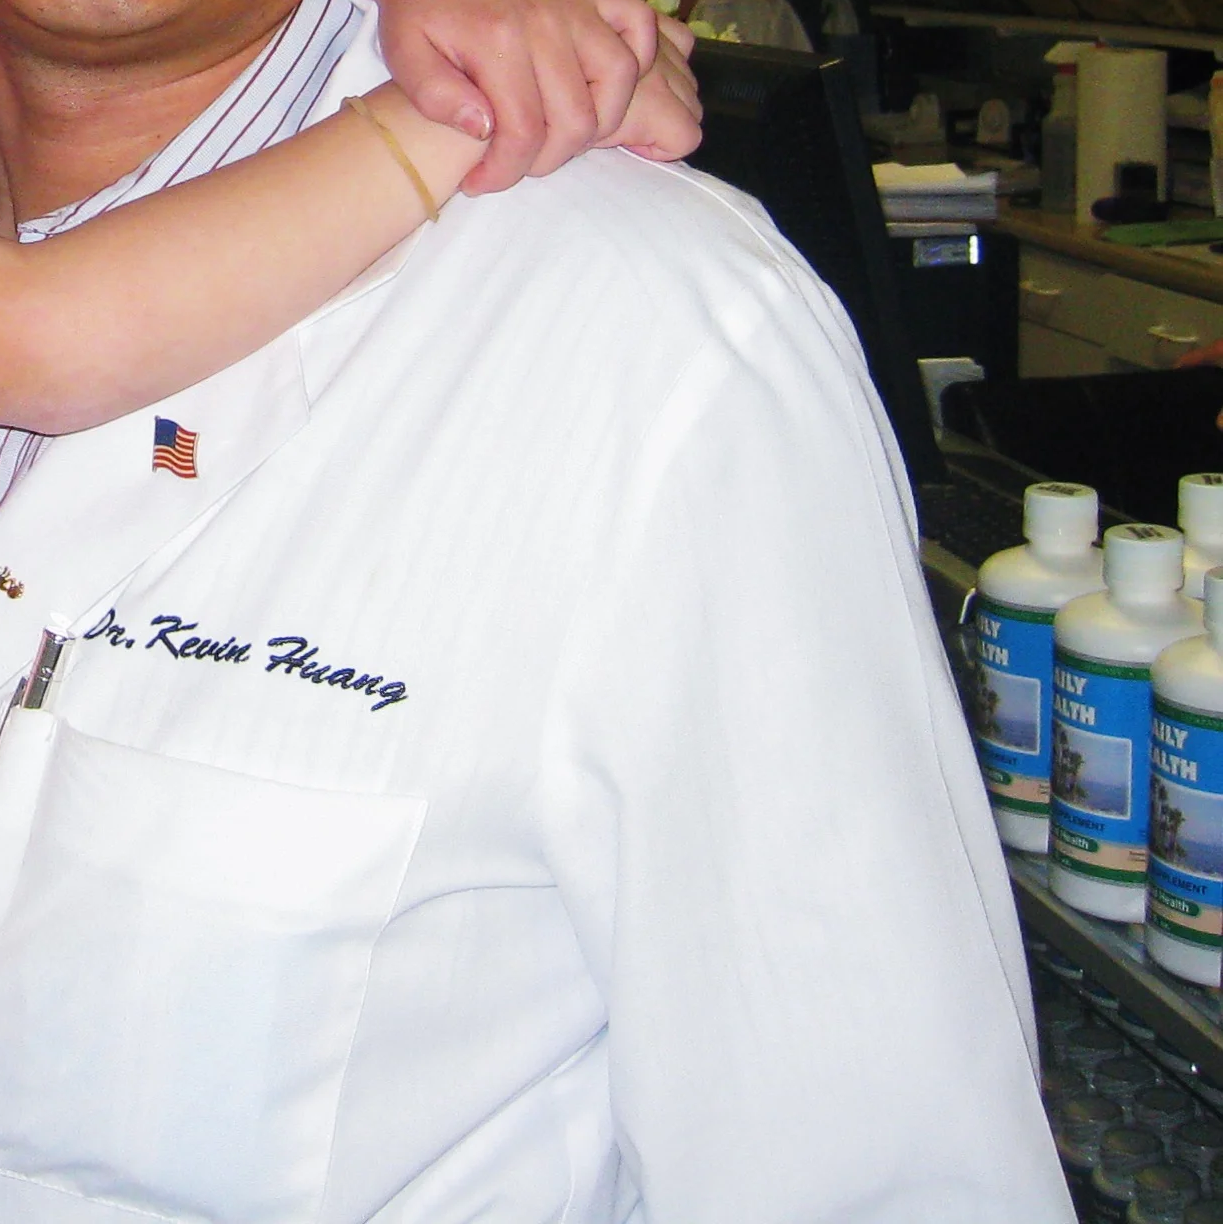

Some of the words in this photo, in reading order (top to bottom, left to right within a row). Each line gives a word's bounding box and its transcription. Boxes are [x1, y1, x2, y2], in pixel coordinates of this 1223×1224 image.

[83, 607, 136, 649] Dr.
[145, 614, 253, 663] Kevin
[264, 635, 410, 712] Huang
